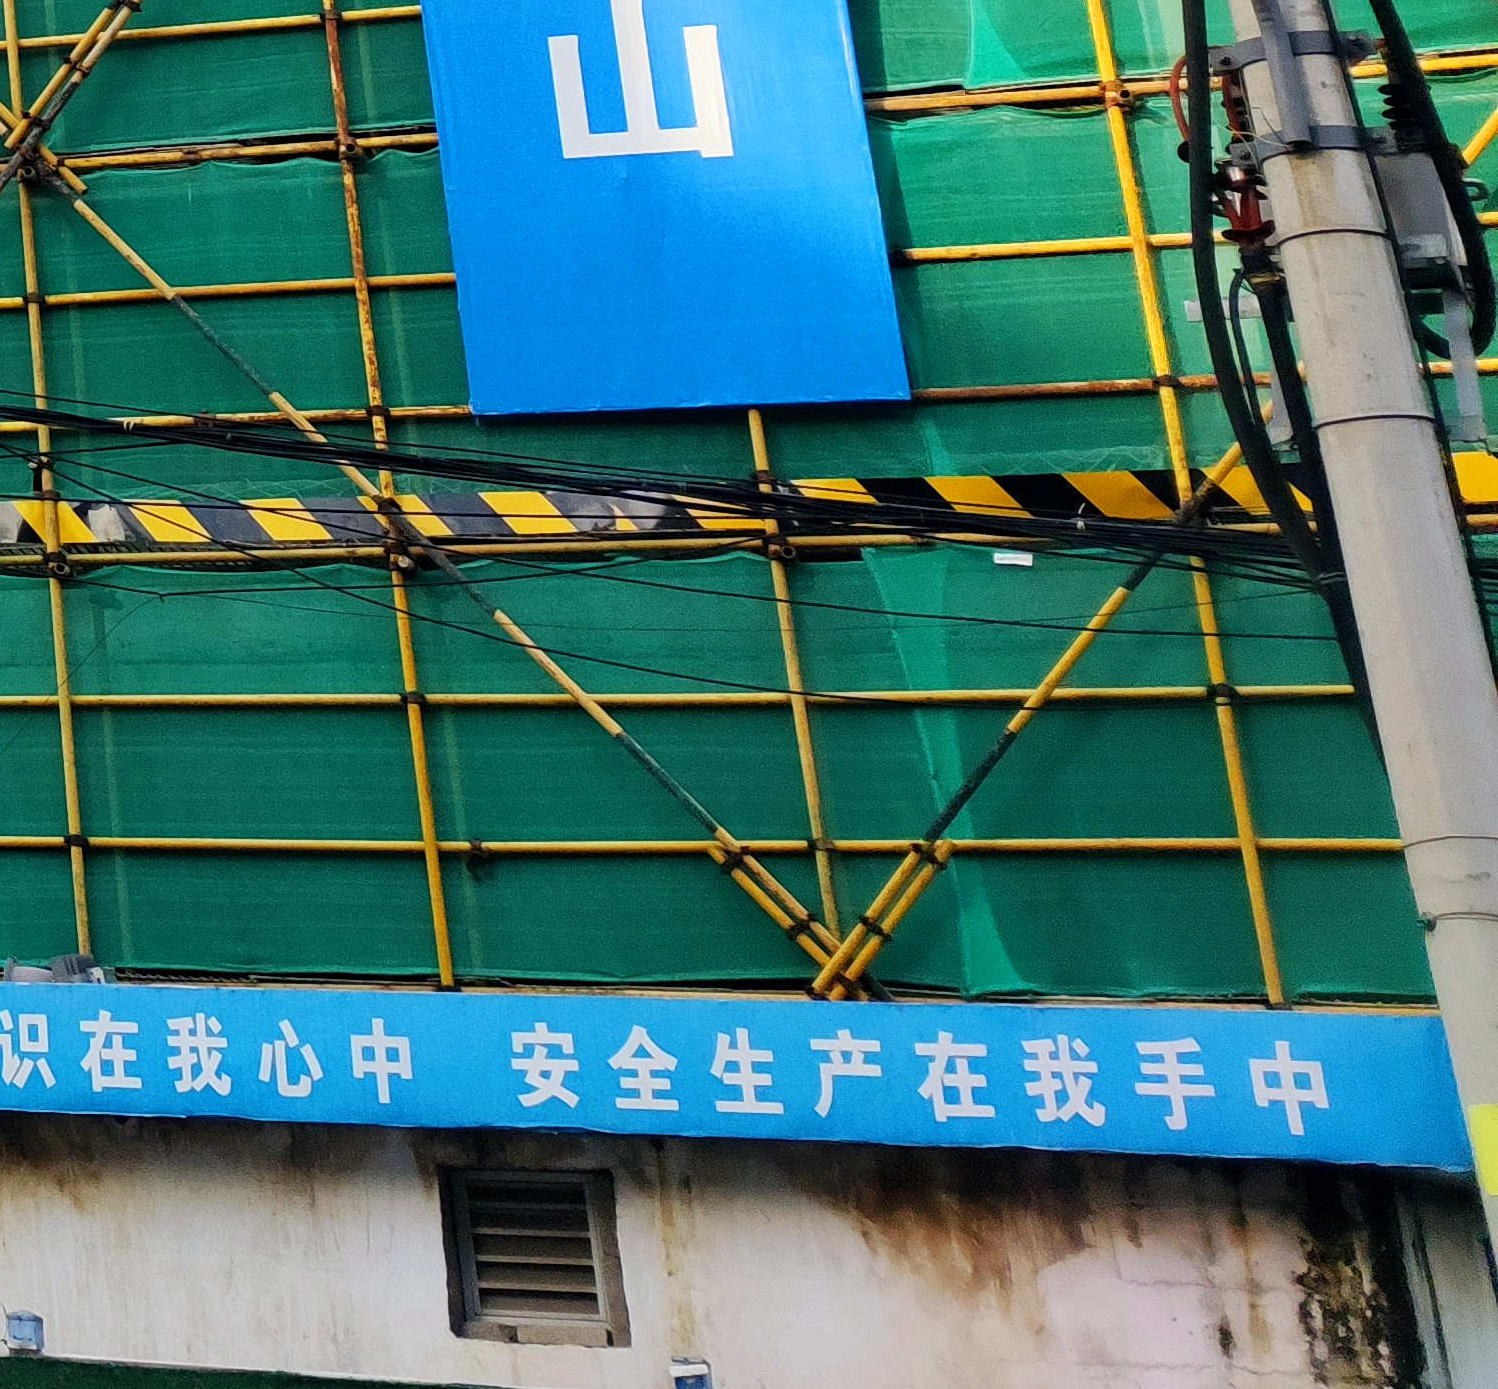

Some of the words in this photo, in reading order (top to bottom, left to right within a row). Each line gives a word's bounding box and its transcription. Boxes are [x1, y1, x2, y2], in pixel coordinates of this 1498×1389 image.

[510, 1022, 1329, 1136] 安全生产在我手中
